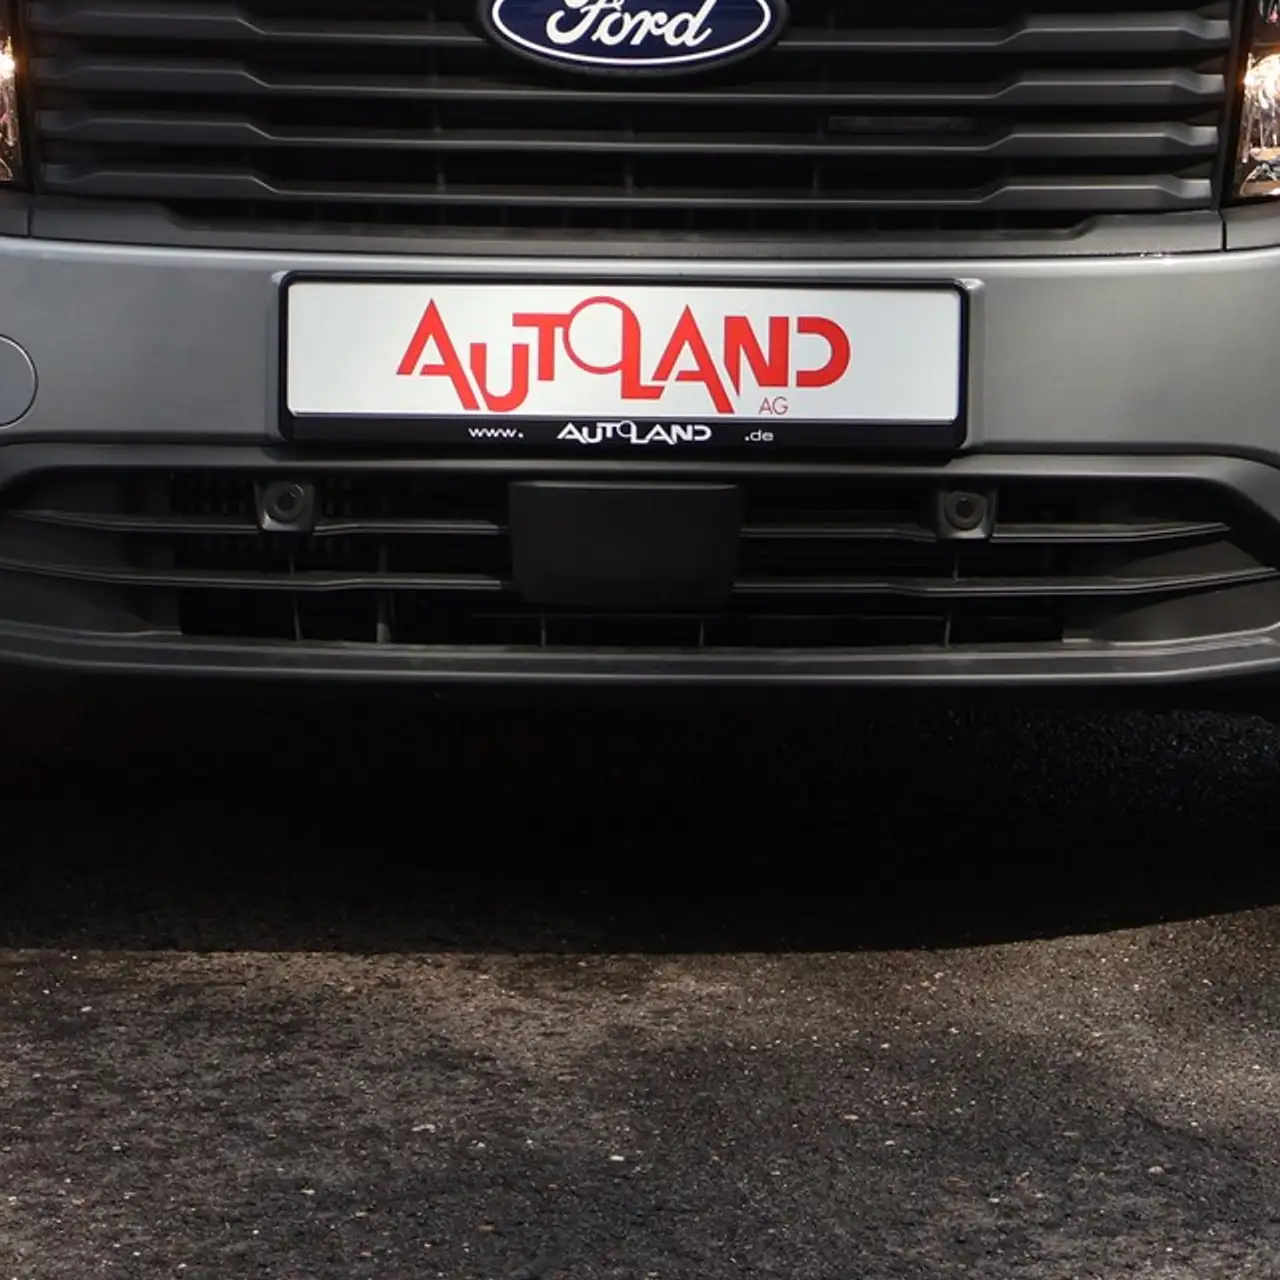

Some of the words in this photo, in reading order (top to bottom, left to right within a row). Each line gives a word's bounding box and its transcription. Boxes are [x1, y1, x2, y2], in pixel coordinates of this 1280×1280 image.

[397, 295, 852, 415] AUTOLAND
[758, 396, 790, 415] AG
[468, 427, 524, 439] www.
[557, 419, 712, 445] AUTOLAND
[744, 429, 775, 442] .de
